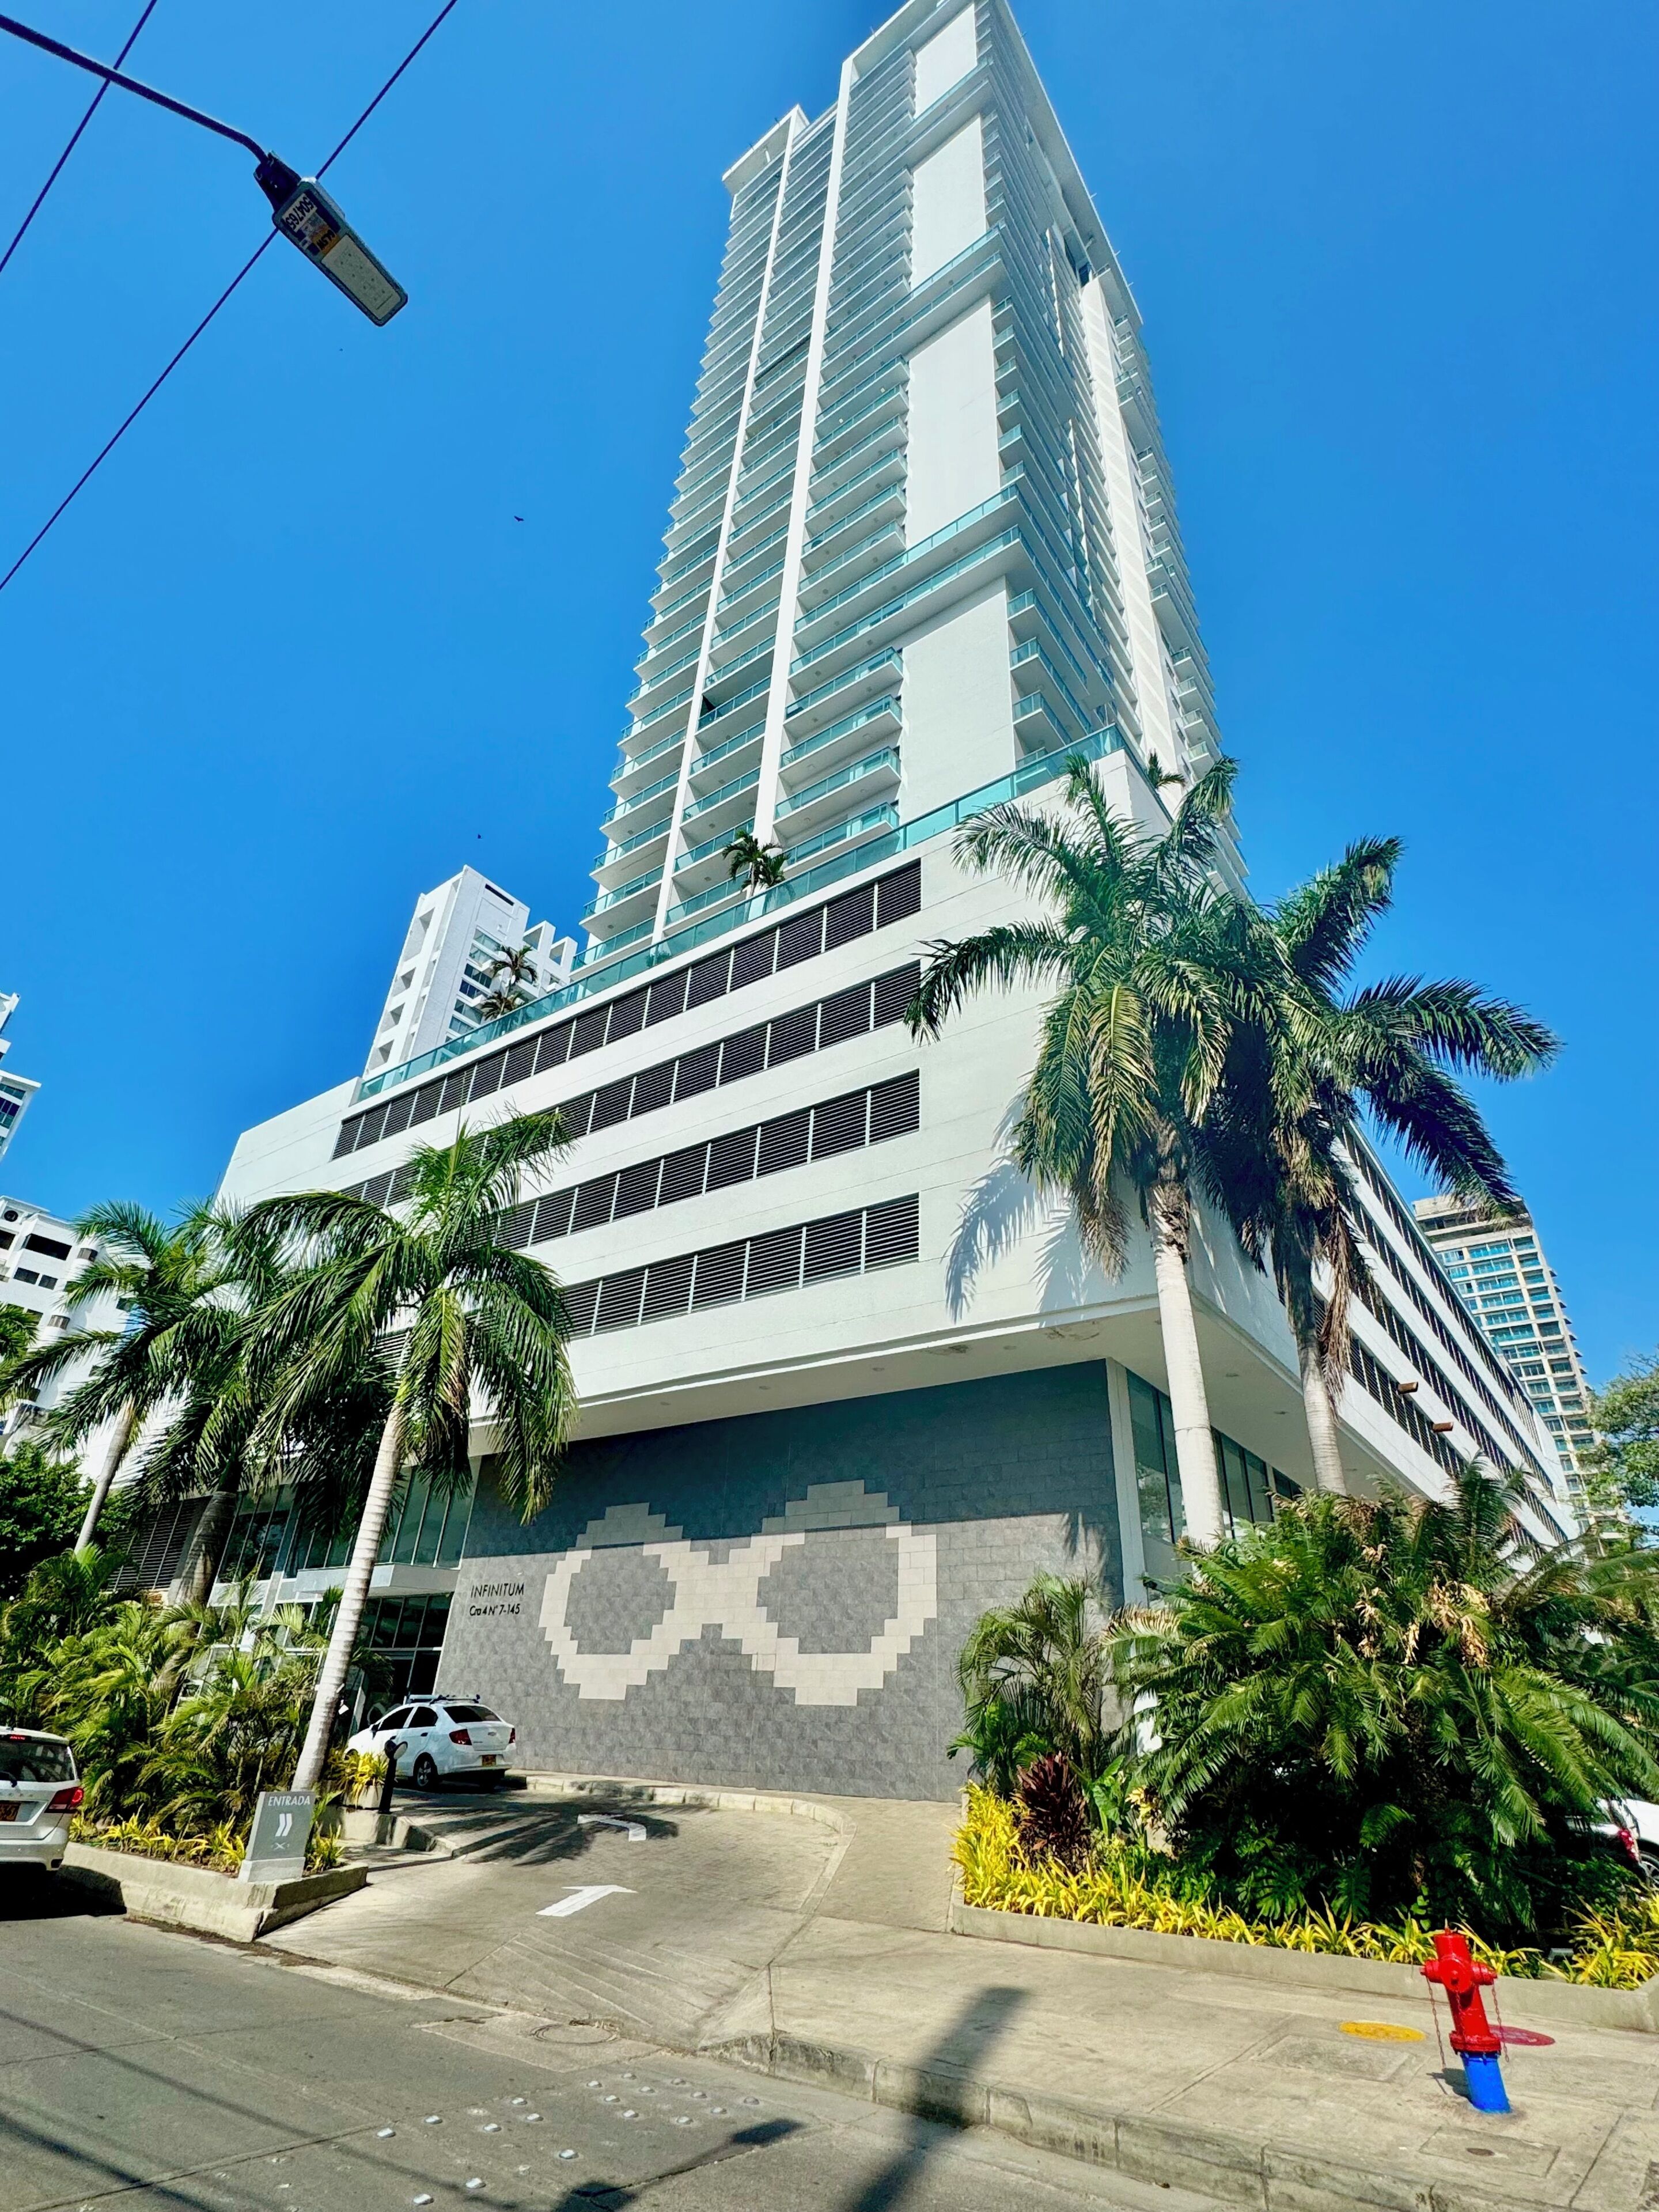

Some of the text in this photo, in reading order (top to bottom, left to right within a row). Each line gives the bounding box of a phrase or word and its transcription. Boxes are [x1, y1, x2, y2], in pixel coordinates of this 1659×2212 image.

[285, 196, 315, 230] 504765
[471, 1582, 524, 1598] INFINITUM
[469, 1605, 482, 1616] Cra
[482, 1605, 488, 1615] 4
[499, 1604, 521, 1615] 7-145
[268, 1796, 310, 1806] ENTRADA
